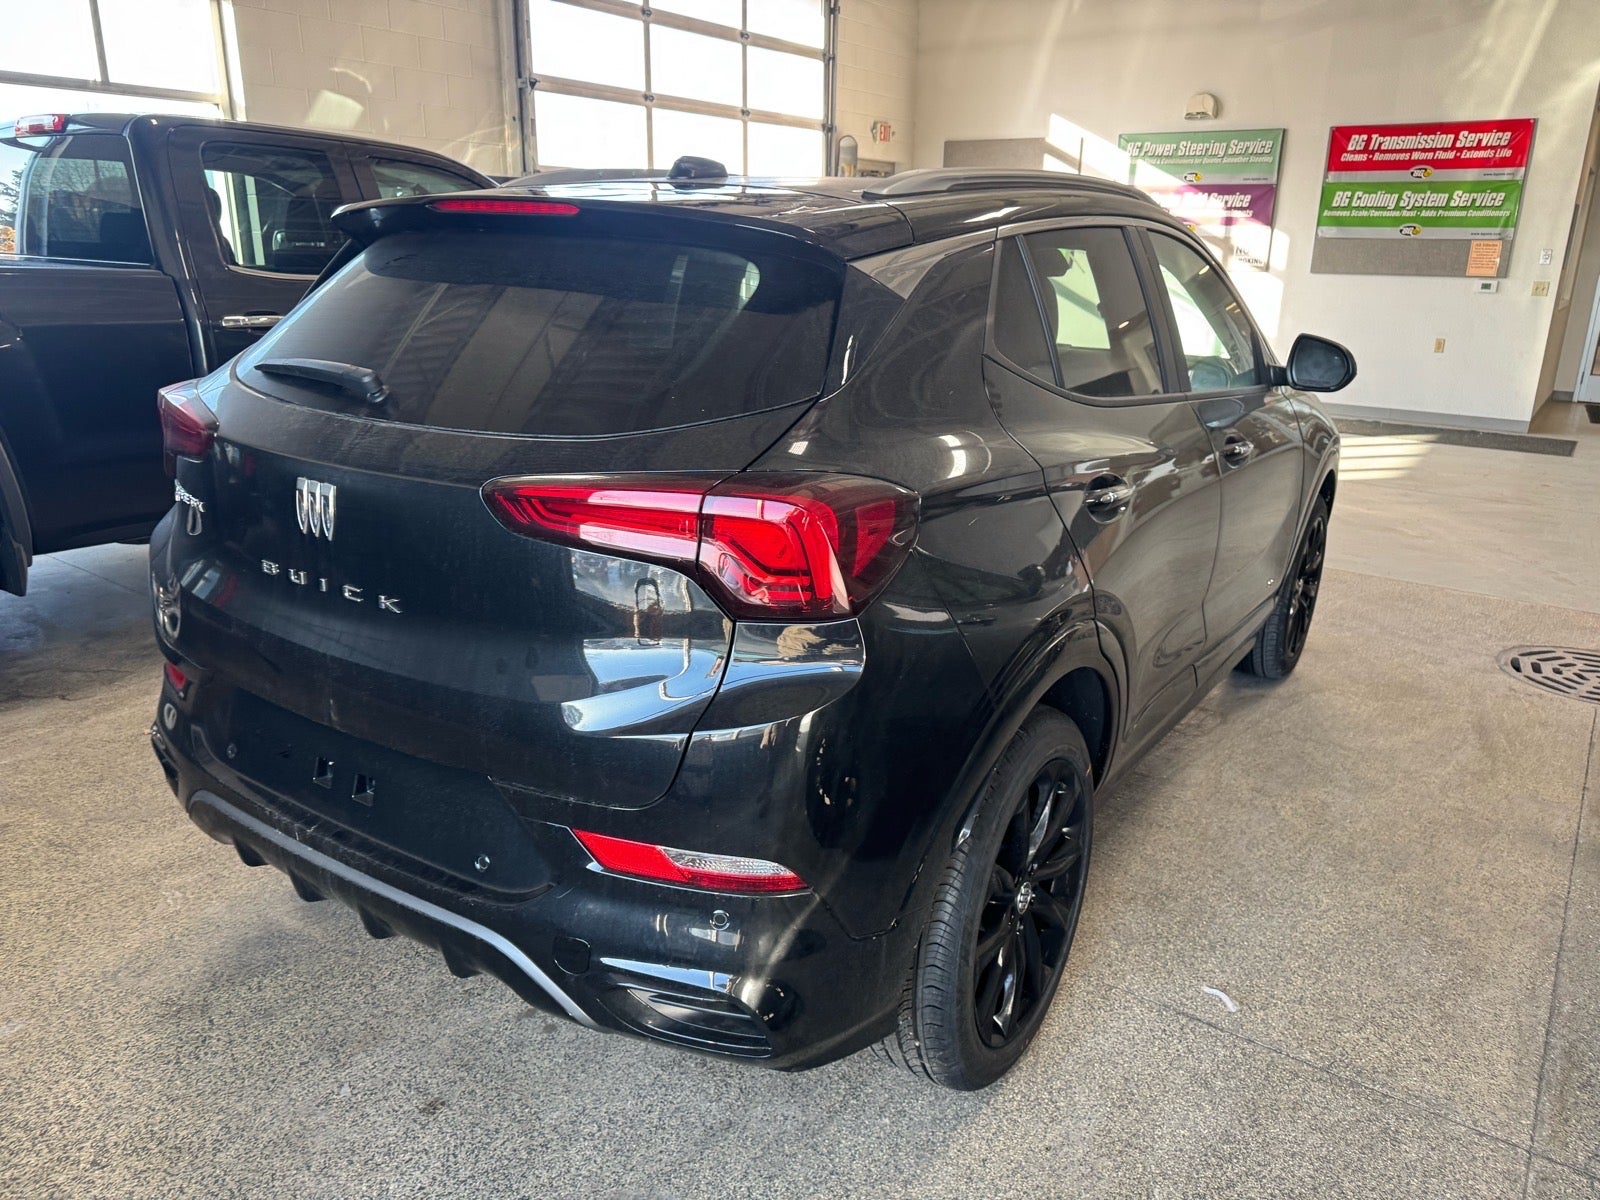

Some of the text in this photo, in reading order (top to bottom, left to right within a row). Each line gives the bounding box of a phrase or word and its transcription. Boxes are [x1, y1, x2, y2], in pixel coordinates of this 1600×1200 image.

[1140, 141, 1177, 157] Power
[1178, 140, 1228, 158] Steering
[1228, 138, 1274, 154] Service
[1347, 129, 1512, 151] BG Transmission Service
[1340, 147, 1513, 162] Cleans Removes Worn Fluid Extends Life
[1207, 192, 1252, 208] Service
[1331, 189, 1506, 210] BG Cooling System Service
[1420, 209, 1437, 217] Adds
[1437, 209, 1467, 217] Premium
[1467, 209, 1511, 217] Conditioners
[261, 559, 404, 614] BUICK
